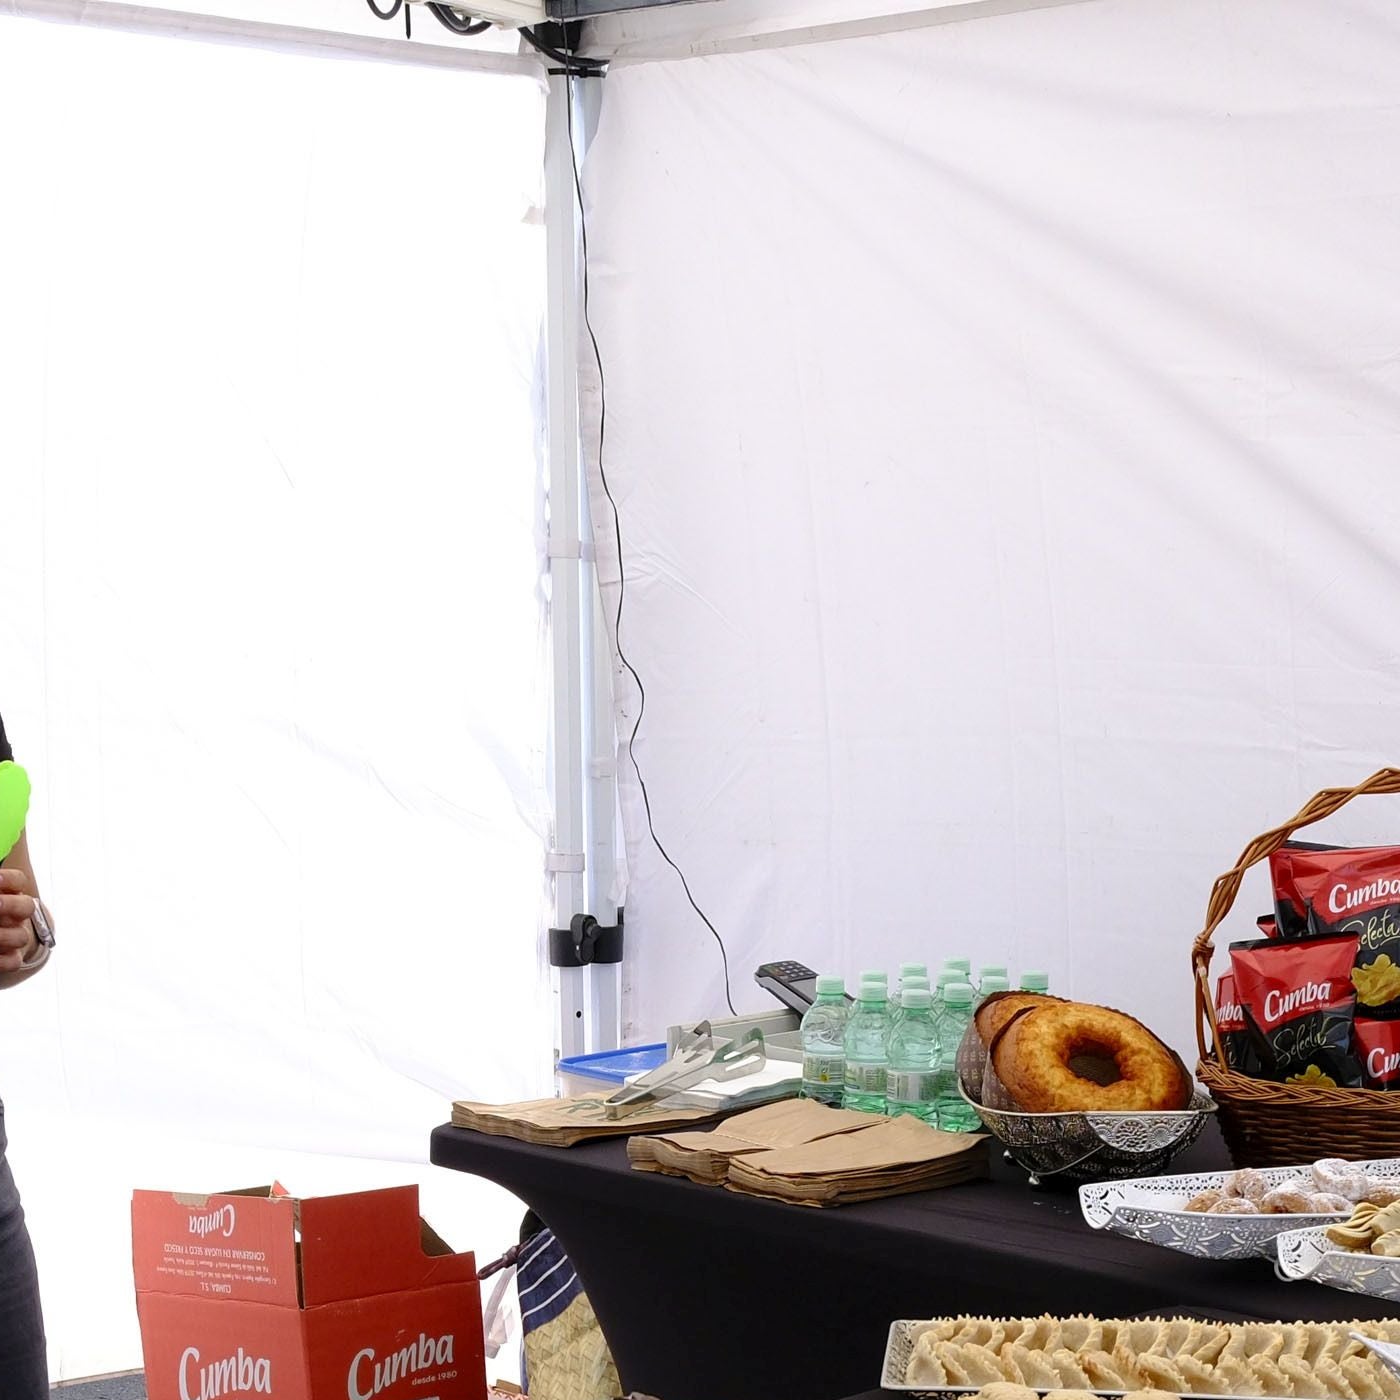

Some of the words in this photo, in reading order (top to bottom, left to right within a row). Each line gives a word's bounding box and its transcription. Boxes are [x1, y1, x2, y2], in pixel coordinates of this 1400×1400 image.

[1264, 981, 1332, 1022] Cumba
[189, 1204, 235, 1238] Cumba
[411, 1374, 436, 1386] desde
[438, 1370, 458, 1381] 1980
